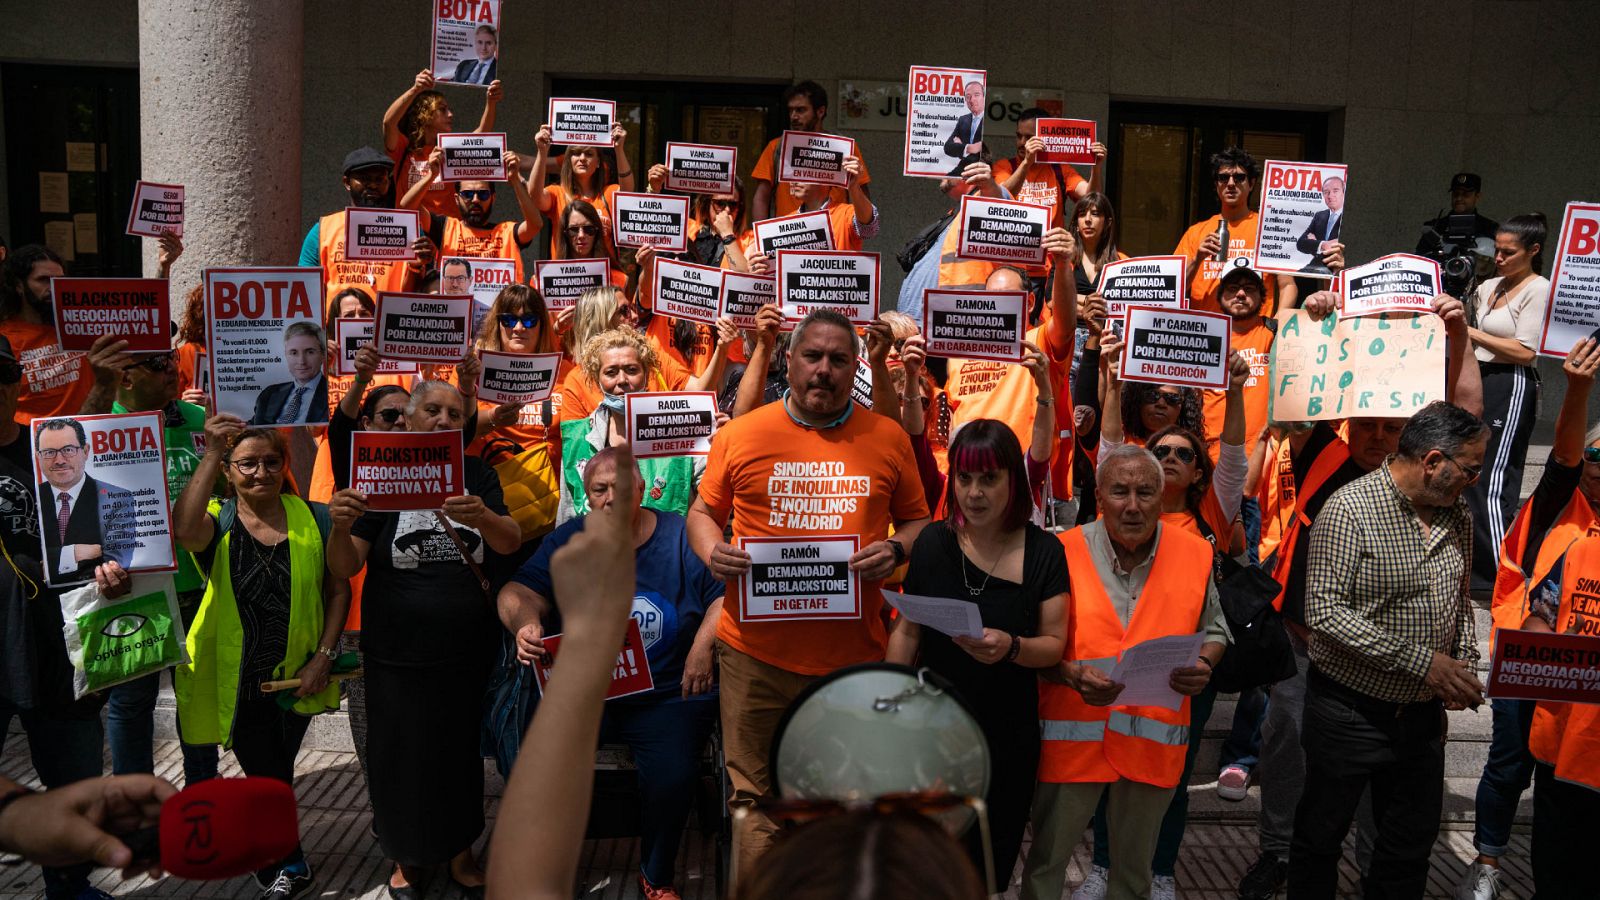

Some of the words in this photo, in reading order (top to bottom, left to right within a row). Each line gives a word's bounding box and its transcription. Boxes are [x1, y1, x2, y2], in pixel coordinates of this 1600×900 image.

[439, 0, 493, 23] BOTA
[915, 73, 965, 96] BOTA
[920, 95, 944, 103] CLAUDIO
[564, 114, 601, 122] DEMANDADA
[571, 123, 608, 131] BLACKSTONE
[1041, 127, 1090, 136] BLACKSTONE
[575, 133, 597, 141] GETAFE
[808, 139, 829, 148] PAULA
[690, 150, 714, 159] VANESA
[800, 149, 835, 160] DESAHUCIO
[682, 161, 721, 170] DEMANDADA
[802, 160, 820, 168] JULIO
[818, 161, 838, 170] 2023
[463, 167, 494, 176] ALCORCÓN
[674, 169, 689, 177] POR
[690, 170, 728, 180] BLACKSTONE
[793, 169, 801, 177] EN
[801, 170, 834, 180] VALLECAS
[687, 180, 720, 189] TORREJÓN
[1269, 168, 1322, 192] BOTA
[1274, 190, 1300, 198] CLAUDIO
[639, 201, 662, 210] LAURA
[141, 211, 157, 220] POR
[628, 213, 672, 223] DEMANDADA
[988, 206, 1027, 219] GREGORIO
[365, 227, 403, 235] DESAHUCIO
[622, 222, 635, 231] POR
[635, 222, 680, 234] BLACKSTONE
[779, 221, 807, 233] MARINA
[981, 220, 1032, 234] DEMANDADO
[627, 236, 636, 244] EN
[637, 234, 672, 245] TORREJÓN
[772, 232, 817, 247] DEMANDADA
[970, 231, 986, 241] POR
[987, 232, 1040, 246] BLACKSTONE
[370, 247, 405, 255] ALCORCÓN
[968, 245, 978, 254] EN
[980, 246, 1037, 258] CARABANCHEL
[560, 266, 586, 274] YAMIRA
[801, 259, 856, 270] JACQUELINE
[1121, 265, 1160, 274] GERMANIA
[475, 269, 511, 283] BOTA
[683, 270, 701, 280] OLGA
[1362, 273, 1421, 285] DEMANDADO
[553, 278, 595, 286] DEMANDADA
[754, 283, 773, 292] OLGA
[800, 275, 858, 288] DEMANDADA
[1115, 278, 1165, 288] DEMANDADA
[662, 288, 675, 298] POR
[670, 280, 712, 296] DEMANDADA
[1105, 289, 1121, 298] POR
[1122, 289, 1175, 299] BLACKSTONE
[1352, 288, 1371, 297] POR
[1372, 283, 1432, 294] BLACKSTONE
[62, 292, 159, 307] BLACKSTONE
[214, 280, 313, 319] BOTA
[790, 289, 807, 299] POR
[809, 290, 869, 302] BLACKSTONE
[1375, 295, 1424, 305] ALCORCÓN
[411, 303, 448, 314] CARMEN
[667, 303, 676, 311] EN
[677, 305, 712, 318] ALCORCÓN
[728, 303, 743, 312] POR
[797, 305, 808, 314] EN
[956, 300, 996, 310] RAMONA
[63, 306, 149, 322] NEGOCIACIÓN
[399, 317, 455, 329] DEMANDADA
[946, 314, 1004, 327] DEMANDADA
[1167, 319, 1207, 333] CARMEN
[65, 323, 128, 336] COLECTIVA
[387, 329, 406, 339] POR
[407, 330, 463, 342] BLACKSTONE
[935, 326, 953, 336] POR
[955, 327, 1015, 340] BLACKSTONE
[1148, 332, 1208, 349] DEMANDADA
[384, 344, 398, 353] EN
[398, 345, 461, 356] CARABANCHEL
[934, 341, 945, 350] EN
[947, 342, 1013, 355] CARABANCHEL
[1135, 346, 1155, 357] POR
[1156, 348, 1219, 364] BLACKSTONE
[510, 360, 533, 369] NURIA
[496, 371, 542, 380] DEMANDADA
[1141, 363, 1154, 373] EN
[1155, 365, 1207, 379] ALCORCÓN
[485, 380, 501, 389] POR
[502, 380, 549, 391] BLACKSTONE
[658, 400, 690, 410] RAQUEL
[649, 414, 701, 426] DEMANDADA
[639, 429, 655, 439] POR
[658, 426, 710, 437] BLACKSTONE
[91, 426, 158, 455] BOTA
[652, 442, 664, 451] EN
[665, 440, 695, 450] GETAFE
[99, 453, 118, 462] JUAN
[119, 452, 141, 460] PABLO
[141, 450, 159, 458] VERA
[358, 446, 450, 463] BLACKSTONE
[357, 463, 441, 480] NEGOCIACIÓN
[774, 461, 845, 477] SINDICATO
[356, 481, 423, 495] COLECTIVA
[771, 479, 789, 494] DE
[792, 479, 868, 496] INQUILINAS
[771, 498, 779, 511] E
[781, 497, 857, 515] INQUILINOS
[769, 512, 785, 527] DE
[787, 513, 843, 530] MADRID
[781, 544, 820, 559] RAMÓN
[768, 565, 834, 579] DEMANDADO
[755, 581, 778, 593] POR
[778, 579, 848, 592] BLACKSTONE
[774, 599, 787, 611] EN
[788, 598, 828, 610] GETAFE
[1498, 675, 1579, 690] COLECTIVA
